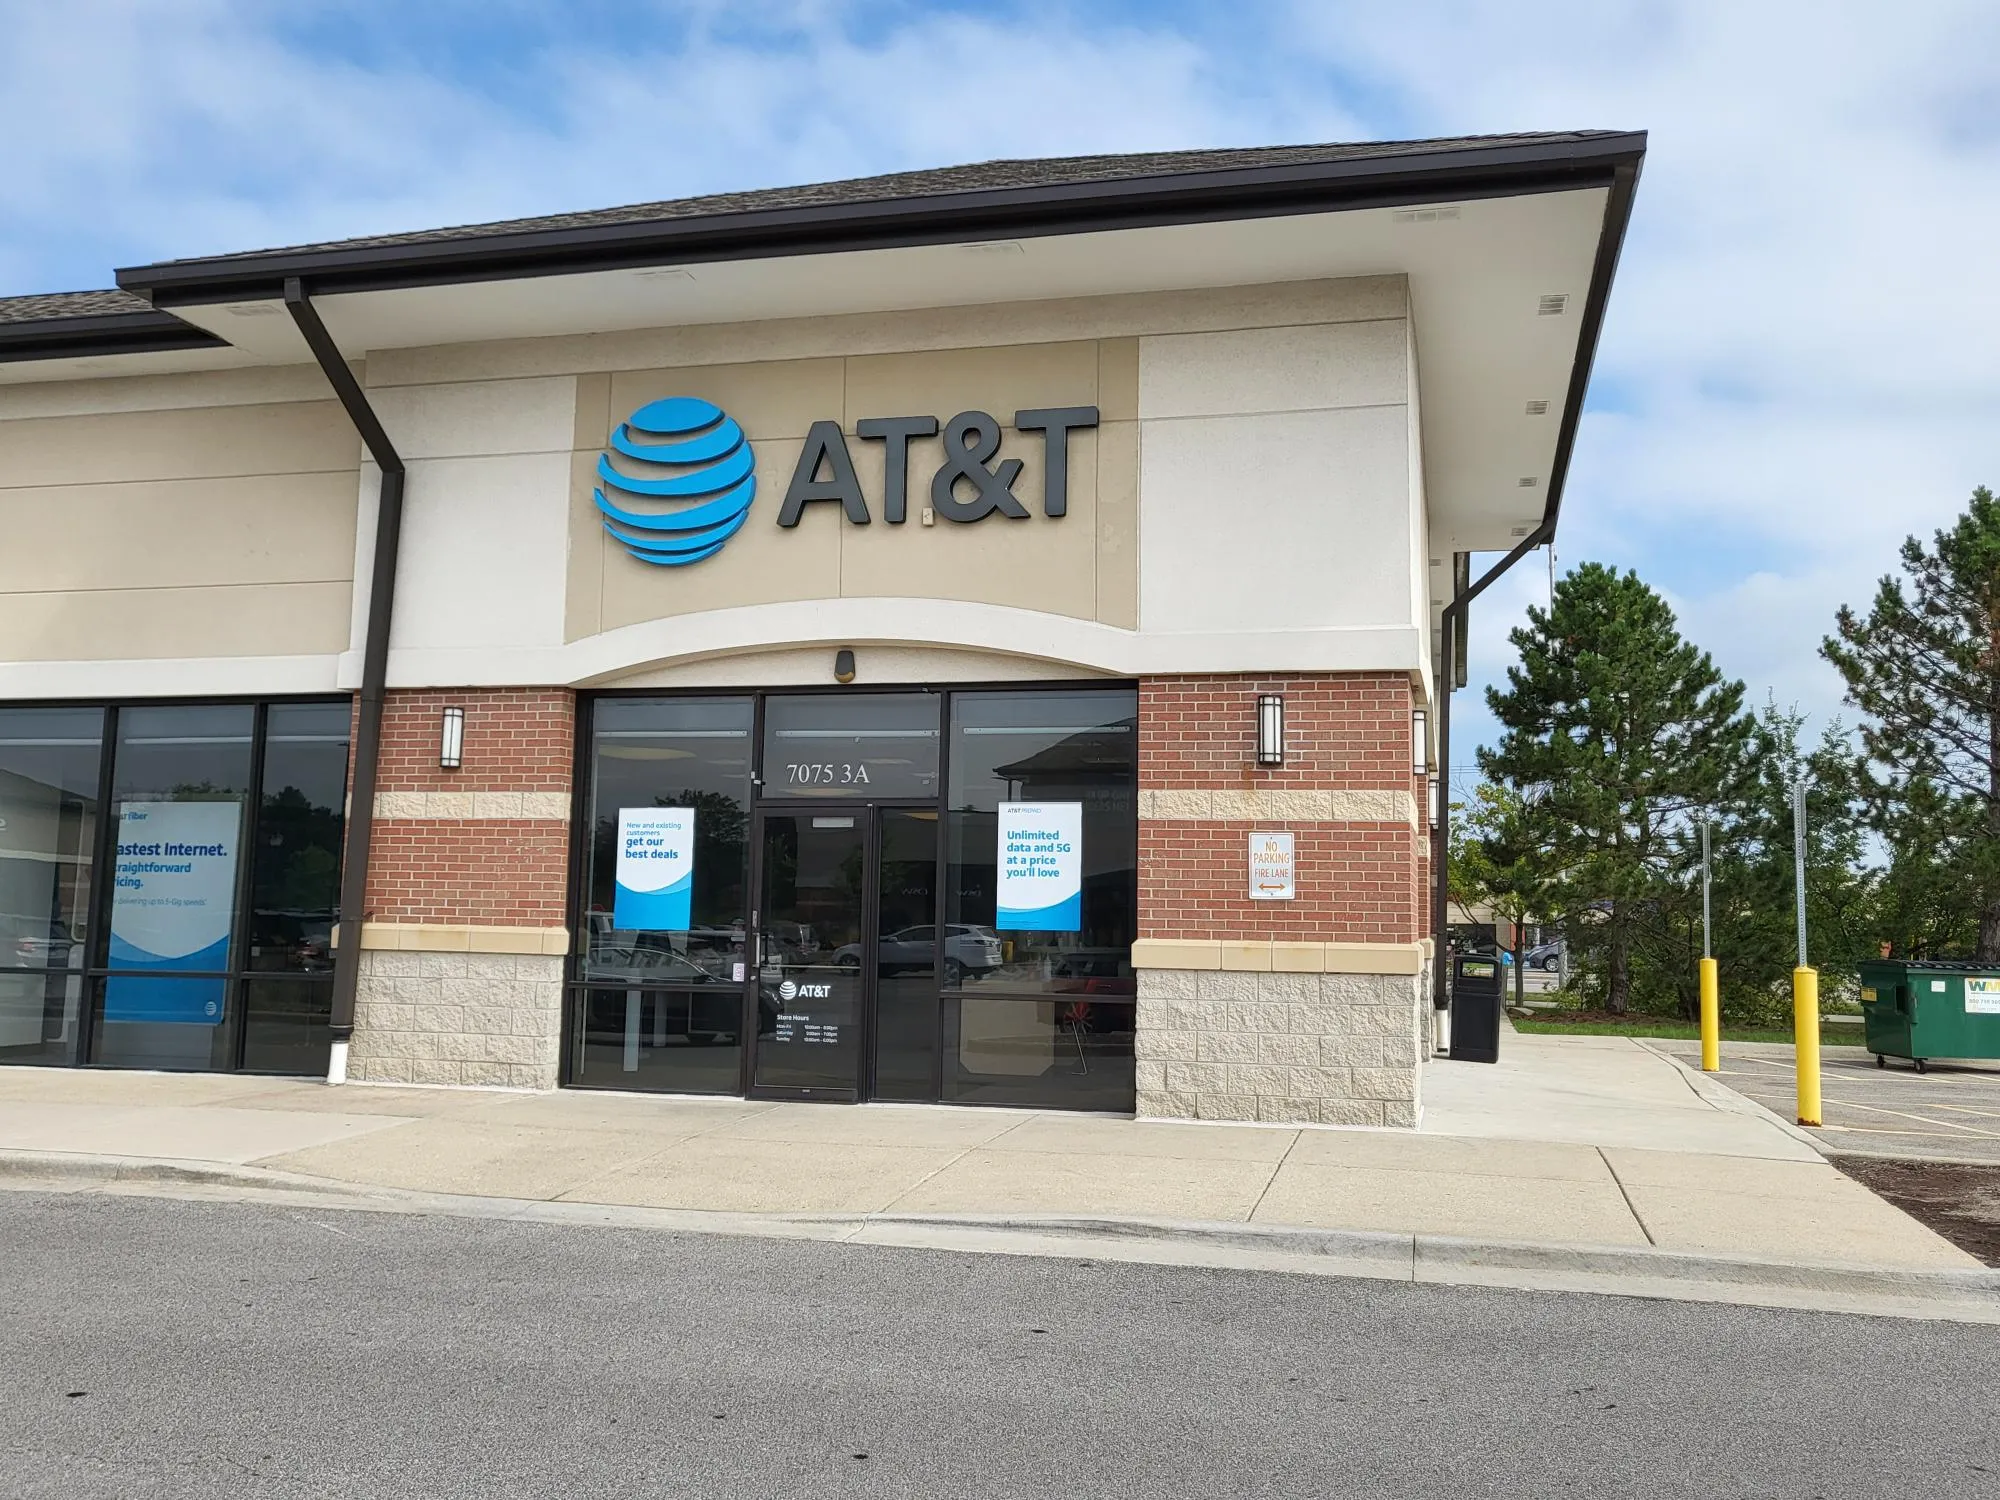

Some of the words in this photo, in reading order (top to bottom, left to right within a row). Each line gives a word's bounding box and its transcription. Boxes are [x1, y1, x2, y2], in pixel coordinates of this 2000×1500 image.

[776, 405, 1100, 527] AT&T
[786, 764, 833, 783] 7075
[840, 764, 871, 783] 3A
[656, 822, 682, 830] existing
[1007, 830, 1060, 840] Unlimited
[626, 838, 643, 848] get
[646, 838, 664, 846] our
[1007, 843, 1031, 853] data
[1034, 843, 1054, 853] and
[1056, 843, 1071, 853] 5G
[1265, 841, 1278, 852] NO
[117, 842, 161, 856] astest
[164, 842, 227, 856] Internet.
[625, 849, 648, 859] best
[651, 849, 678, 859] deals
[1006, 856, 1017, 865] at
[1020, 857, 1026, 865] a
[1030, 855, 1056, 867] price
[1253, 853, 1290, 864] PARKING
[115, 862, 192, 875] raightforward
[1006, 868, 1034, 879] you'll
[1038, 868, 1060, 877] love
[1255, 869, 1270, 878] FIRE
[1271, 869, 1289, 878] LANE
[115, 876, 144, 889] icing.
[798, 985, 831, 998] AT&T
